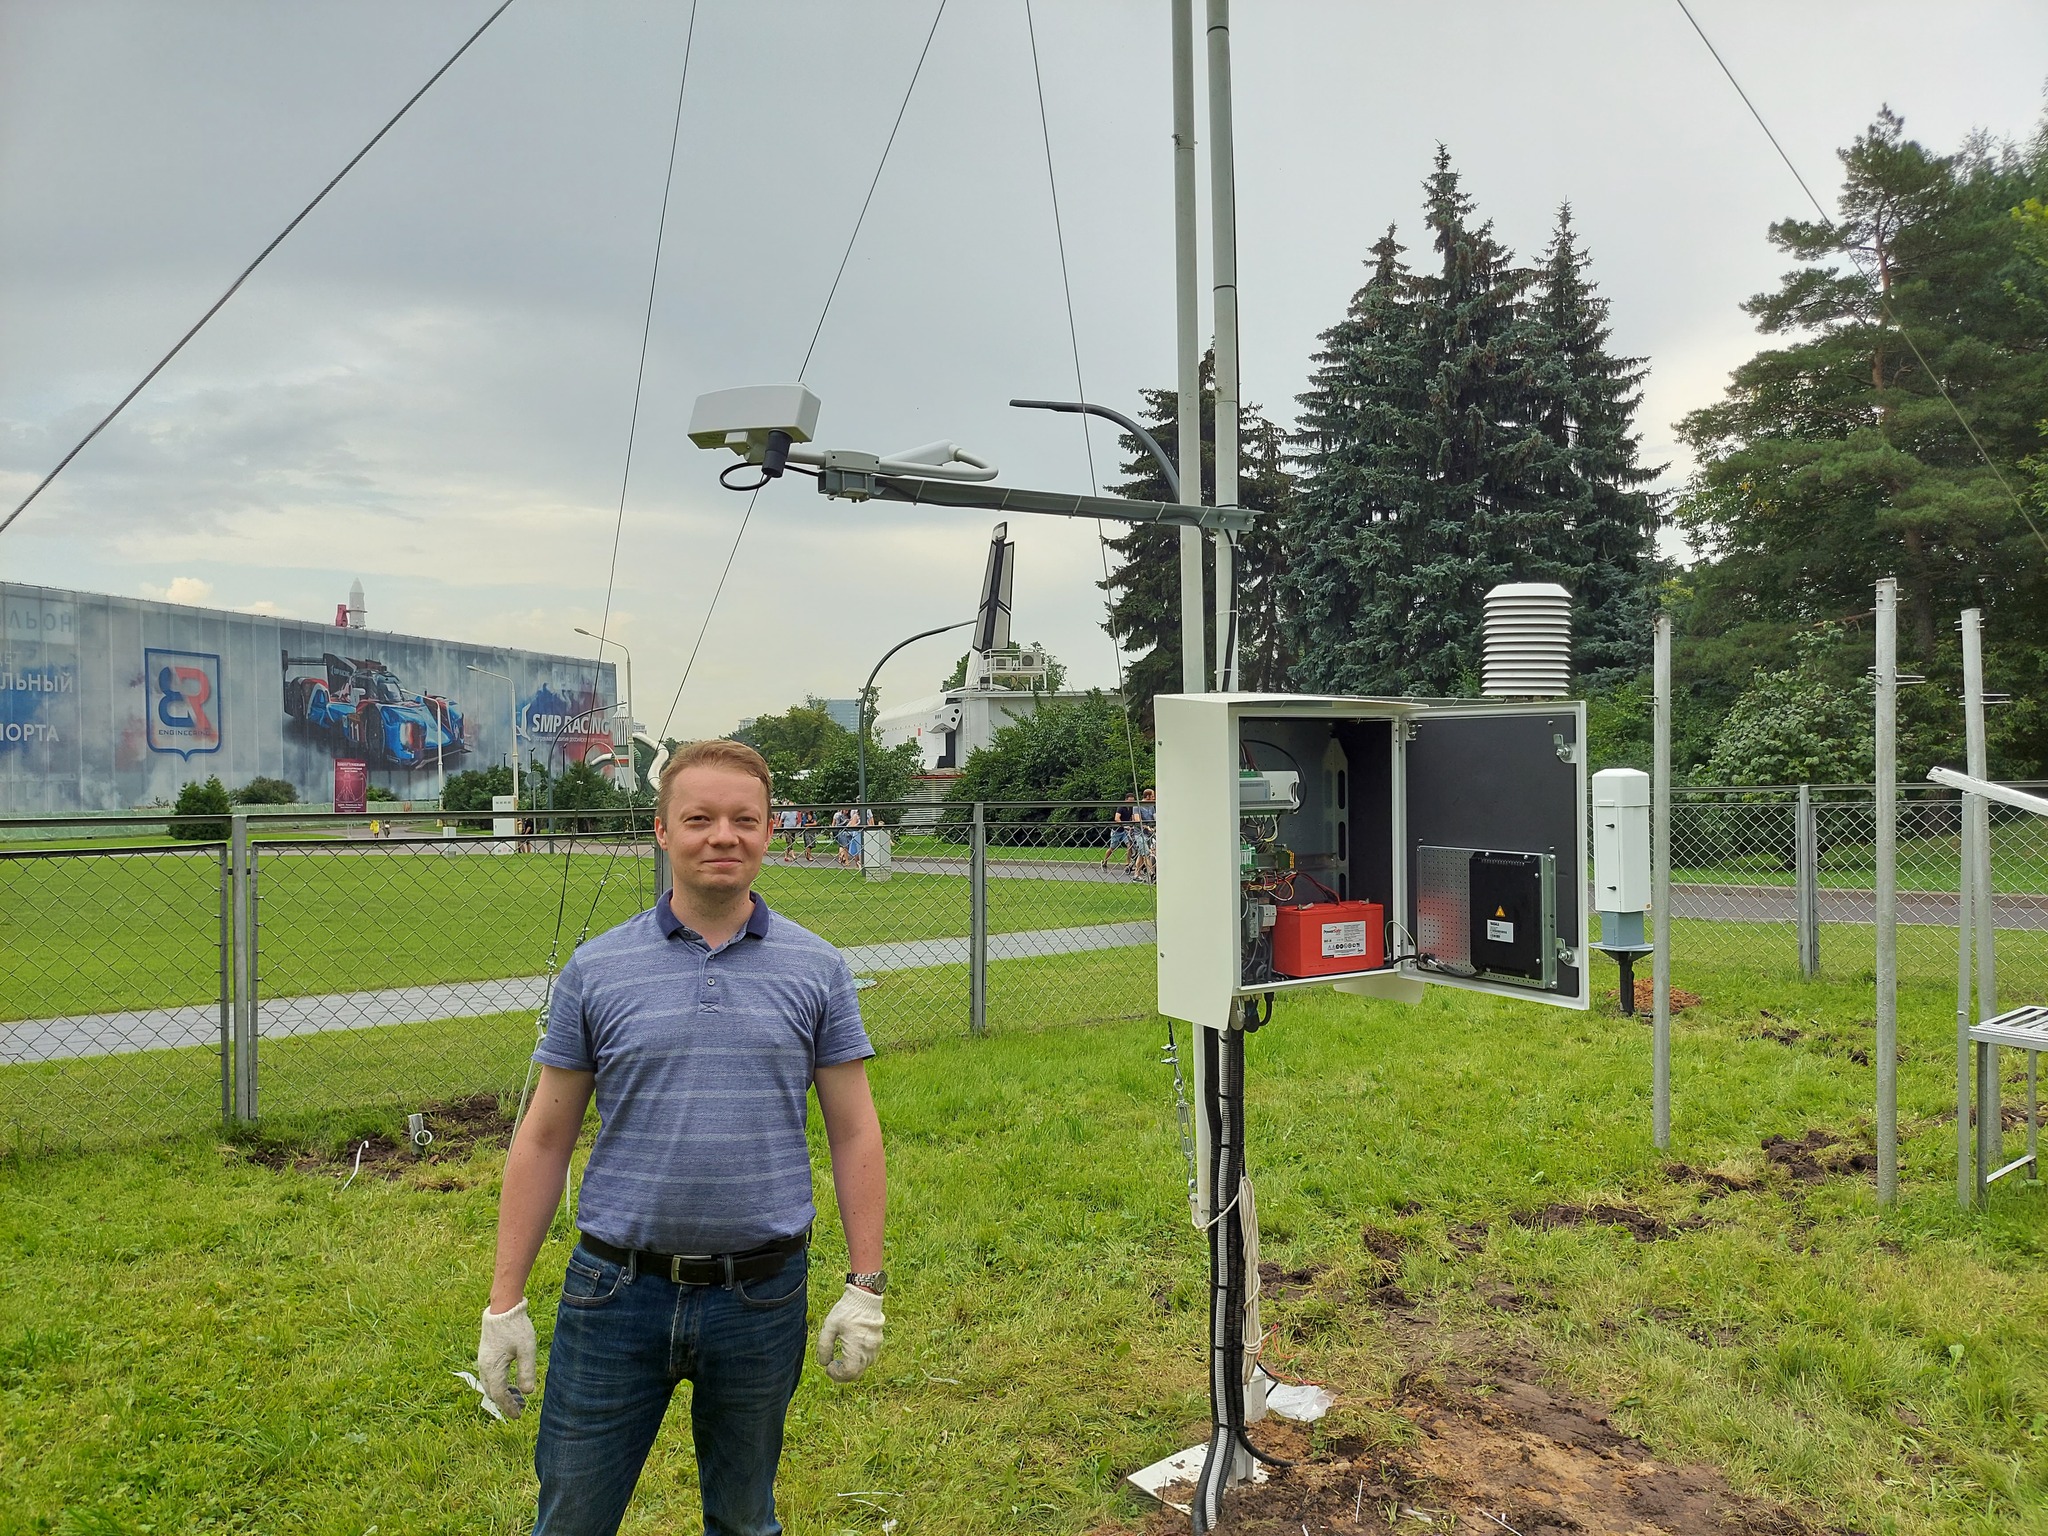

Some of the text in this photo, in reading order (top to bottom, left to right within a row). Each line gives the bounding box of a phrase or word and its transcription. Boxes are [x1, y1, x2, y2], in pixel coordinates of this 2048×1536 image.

[0, 672, 73, 693] ЛЬНЫЙ
[532, 713, 611, 736] SMP RACING
